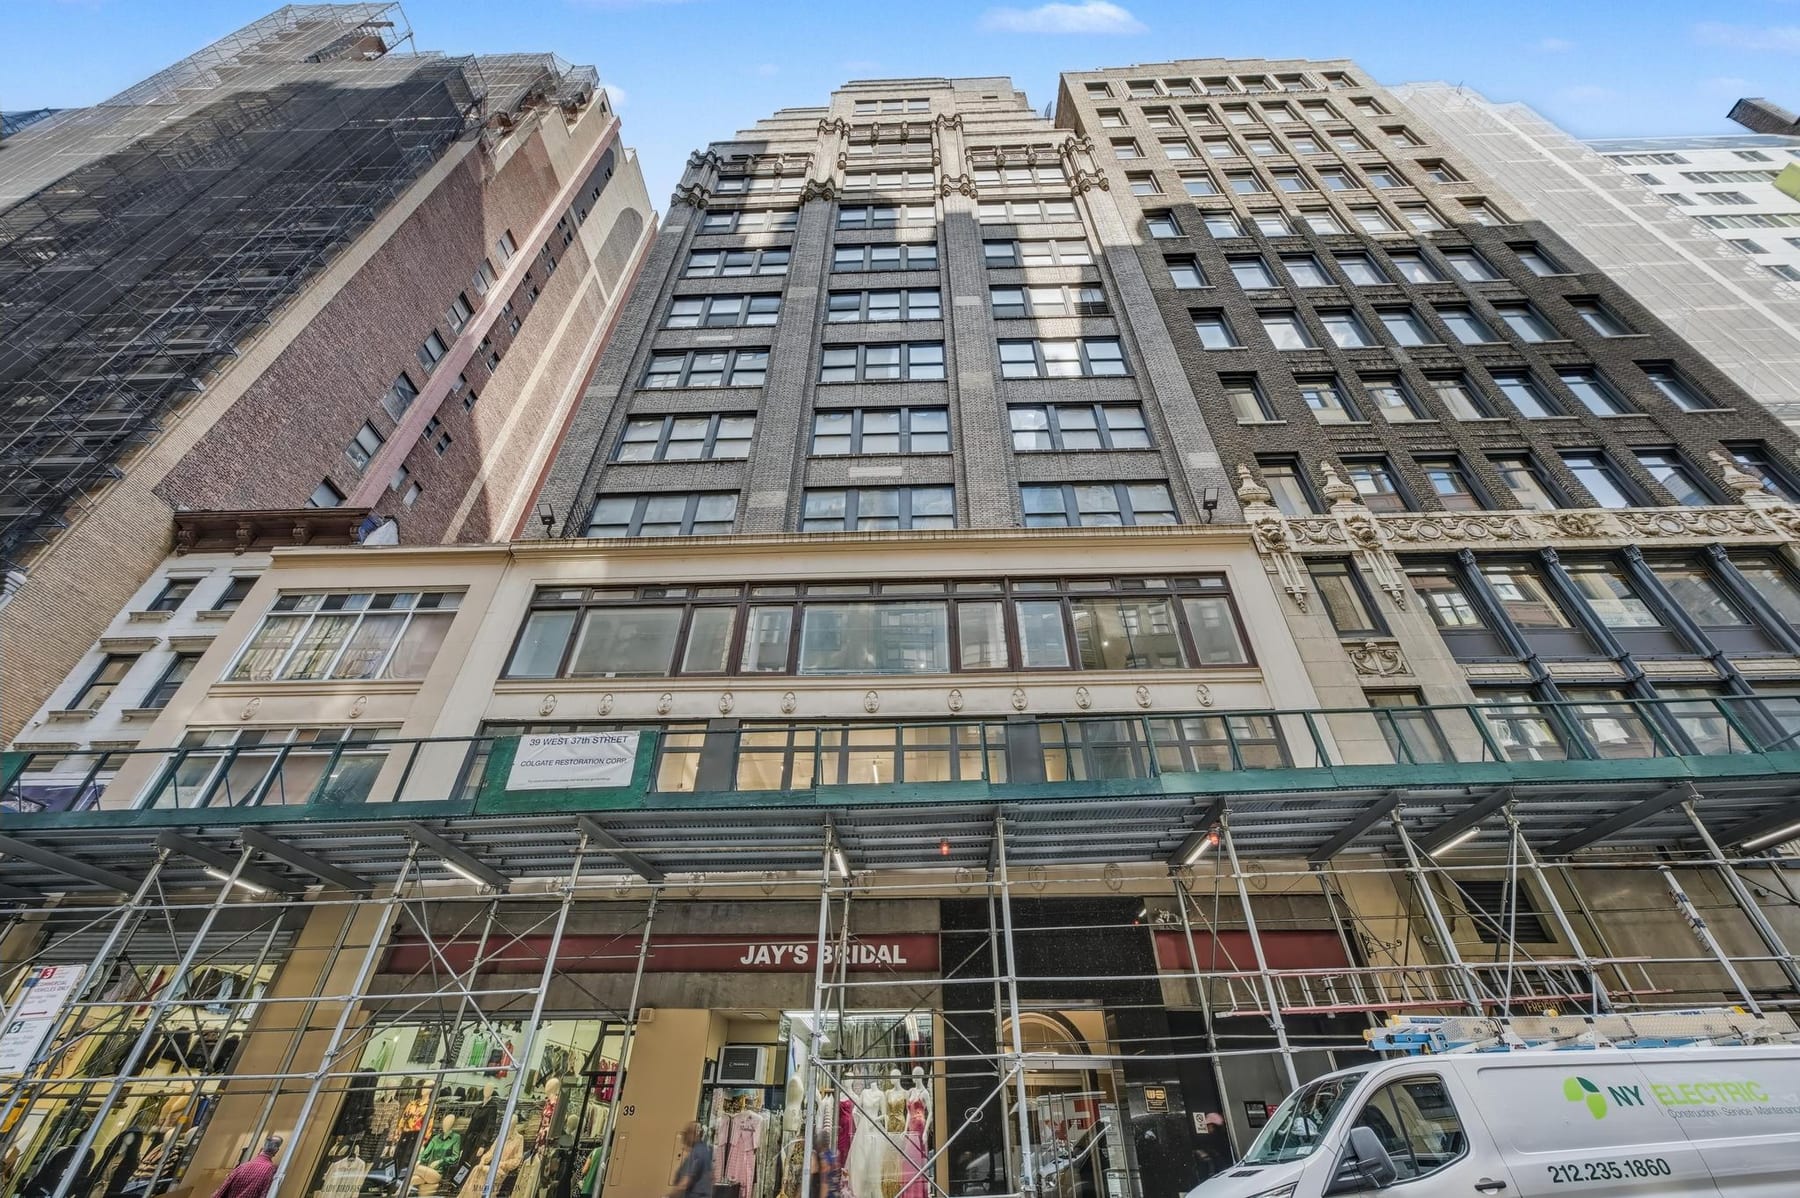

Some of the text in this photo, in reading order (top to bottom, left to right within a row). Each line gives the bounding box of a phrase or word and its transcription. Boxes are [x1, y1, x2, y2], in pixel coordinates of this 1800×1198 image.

[529, 735, 628, 746] 39 WEST 37th STREET
[520, 759, 553, 767] COLGATE
[554, 758, 604, 766] RESTORATION
[740, 944, 907, 965] JAY'S BRIDAL
[1527, 1000, 1562, 1013] FREIGHT
[1607, 1080, 1769, 1108] NY ELECTRIC
[623, 1105, 635, 1116] 39
[1667, 1108, 1719, 1120] Construction
[1721, 1106, 1753, 1117] Service
[1547, 1157, 1672, 1184] 212.235.1860
